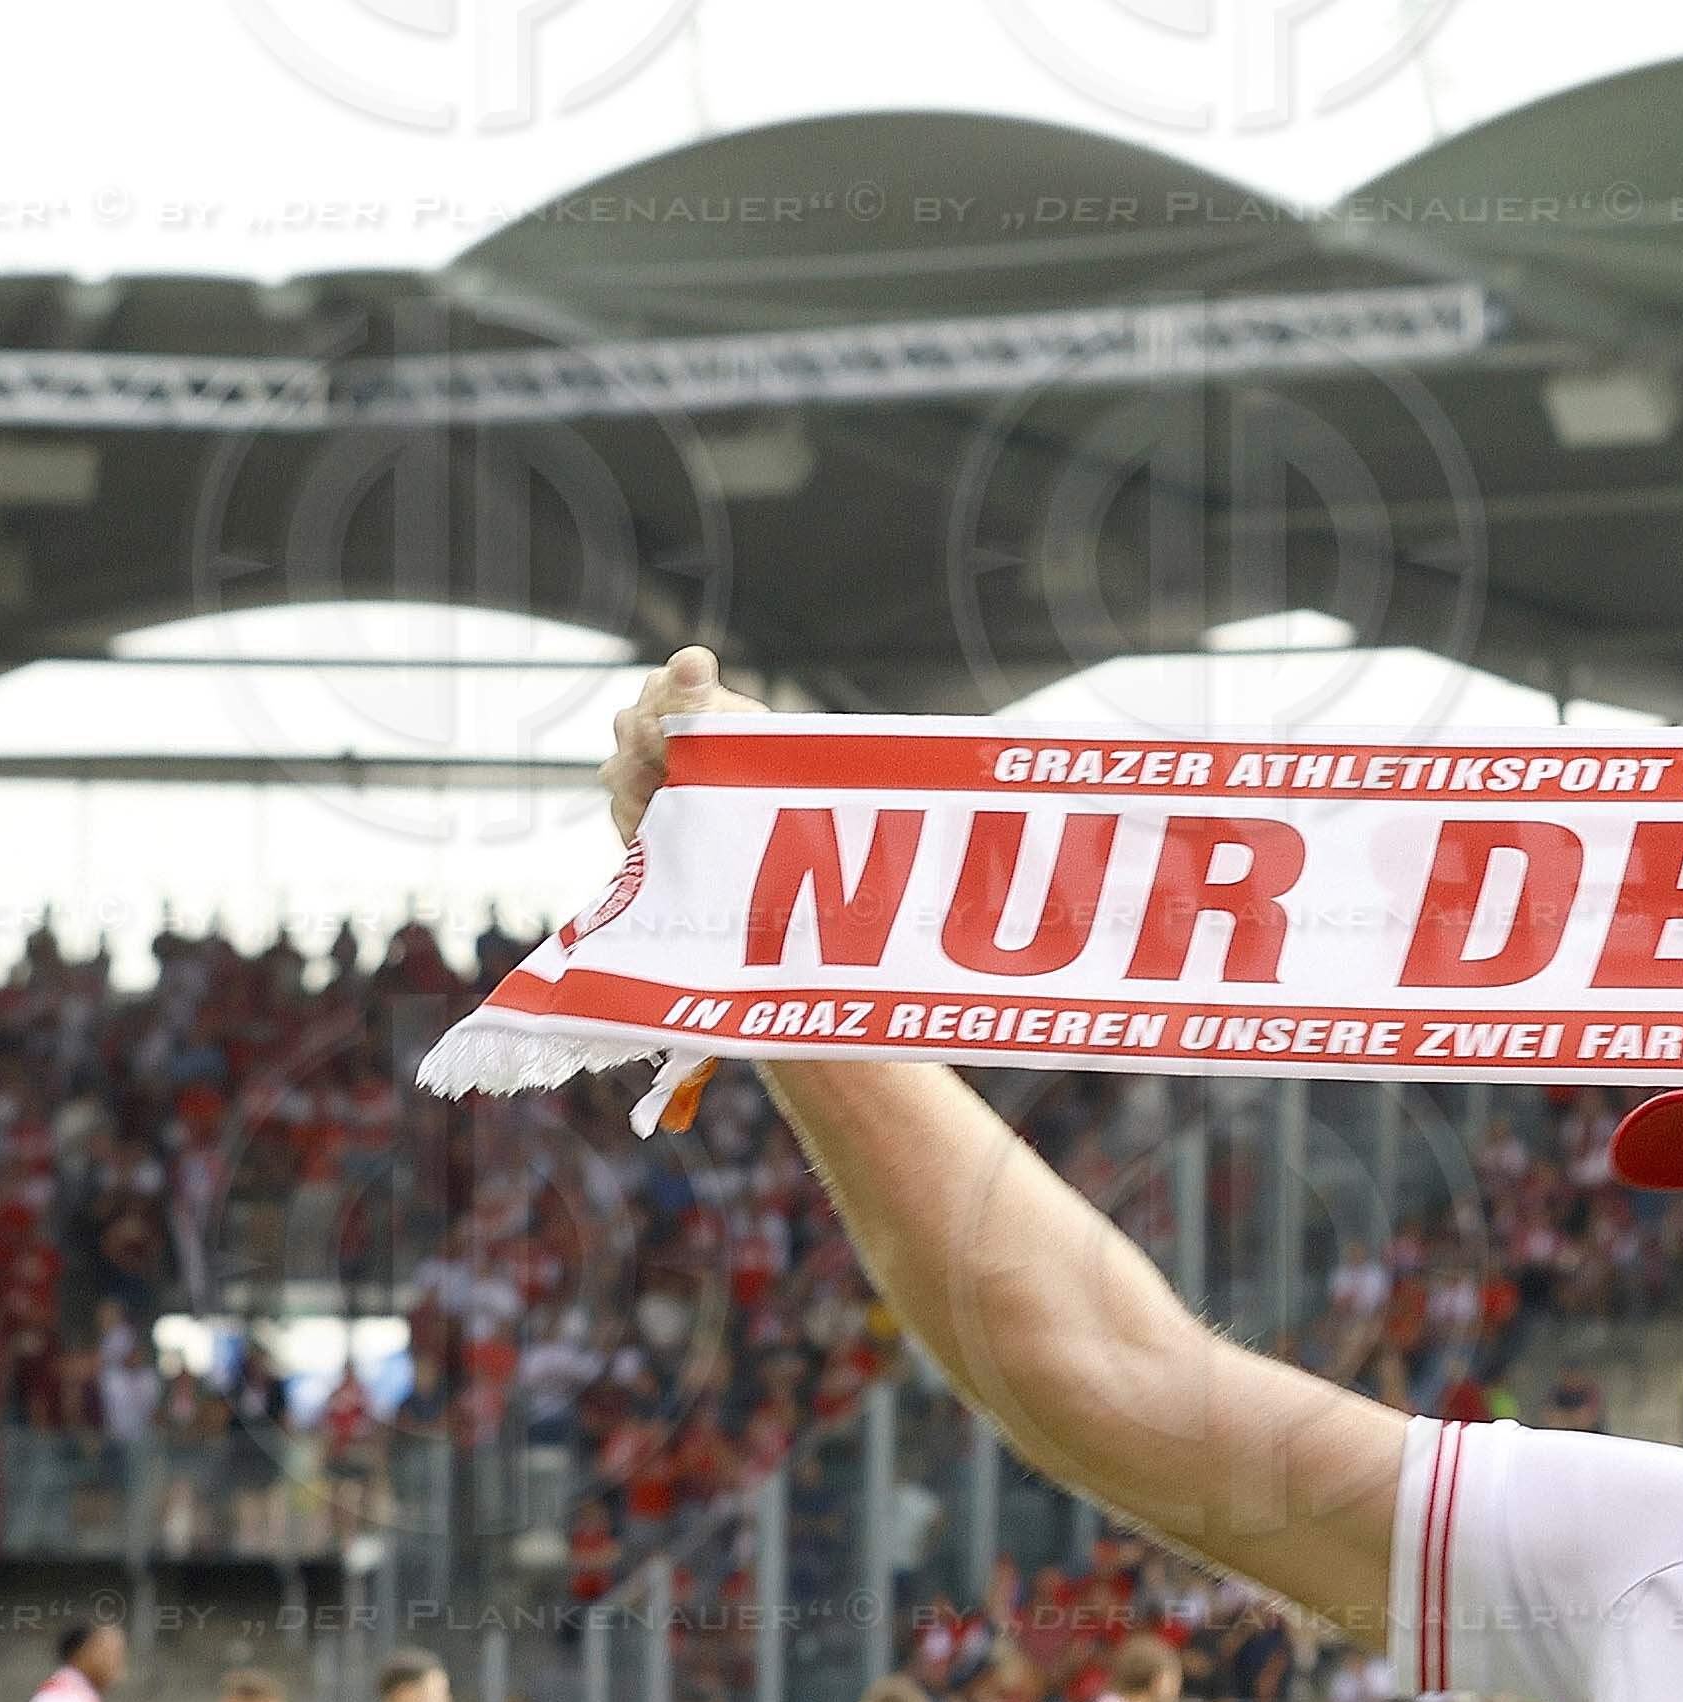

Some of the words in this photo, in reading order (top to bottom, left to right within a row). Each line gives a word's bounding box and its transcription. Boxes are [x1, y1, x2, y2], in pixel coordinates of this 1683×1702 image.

[993, 746, 1212, 786] GRAZER
[1225, 751, 1675, 793] ATHLETIKSPORT
[741, 805, 1309, 983] NUR
[661, 994, 733, 1030] IN
[738, 1000, 877, 1039] GRAZ
[886, 1003, 1172, 1048] REGIEREN
[1178, 1015, 1405, 1058] UNSERE
[1418, 1020, 1566, 1060] ZWEI
